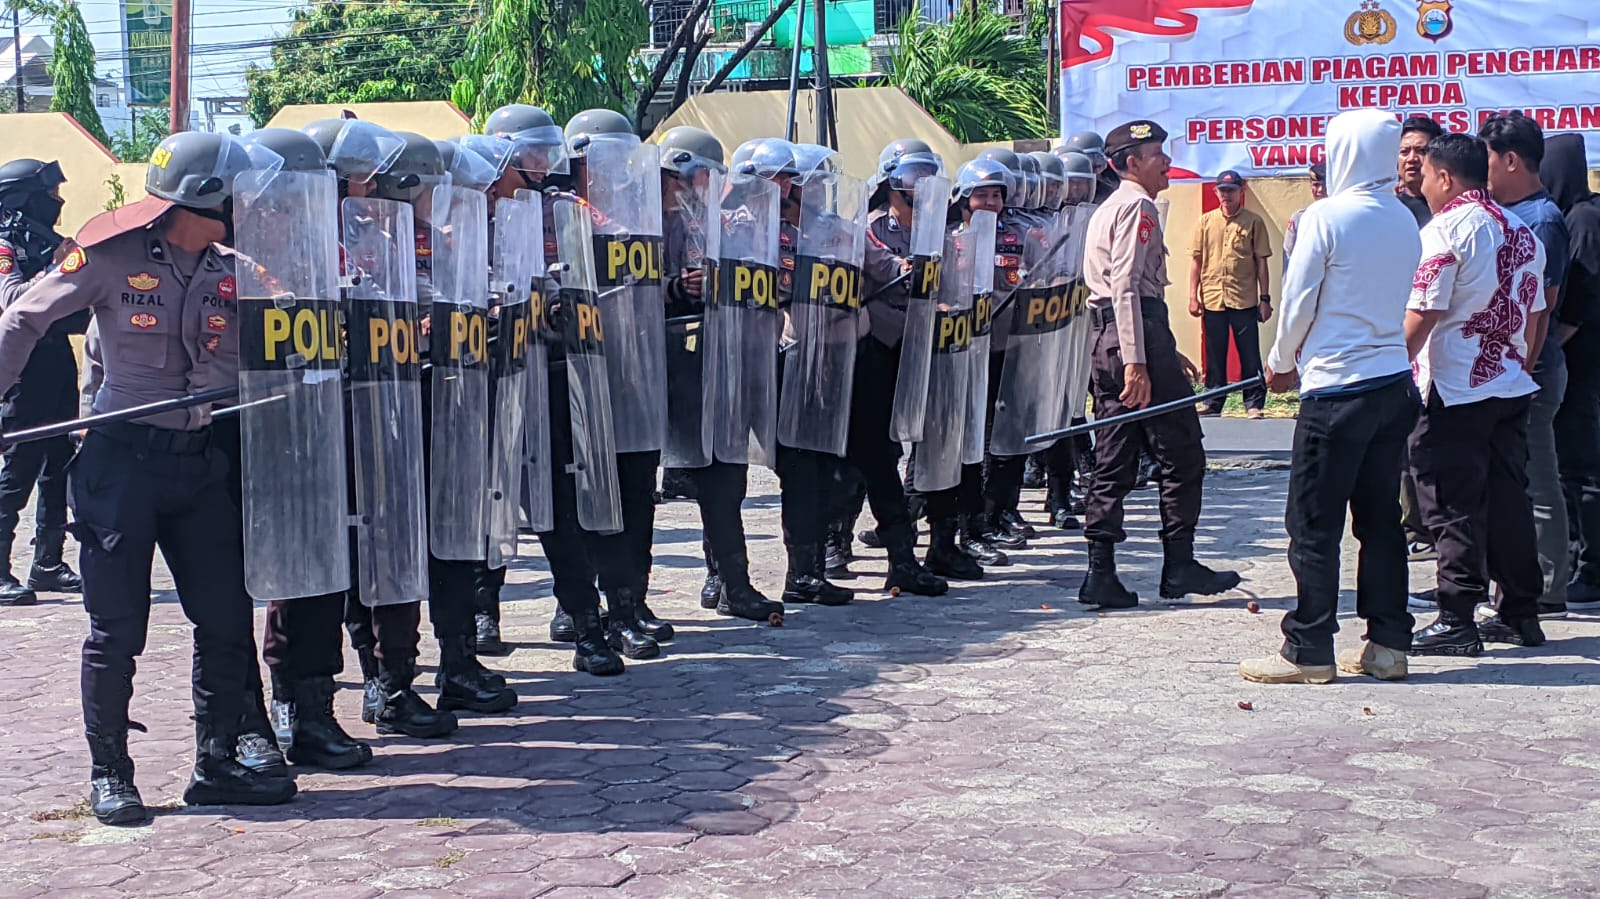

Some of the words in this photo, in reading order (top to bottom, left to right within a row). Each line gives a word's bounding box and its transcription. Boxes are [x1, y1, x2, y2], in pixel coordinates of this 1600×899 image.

[1127, 60, 1303, 90] PEMBERIAN
[1311, 54, 1438, 82] PIAGAM
[1447, 47, 1600, 77] PENGHAR
[1339, 82, 1464, 109] KEPADA
[1187, 115, 1336, 142] PERSONE
[1249, 143, 1326, 168] YANG
[121, 292, 165, 307] RIZAL
